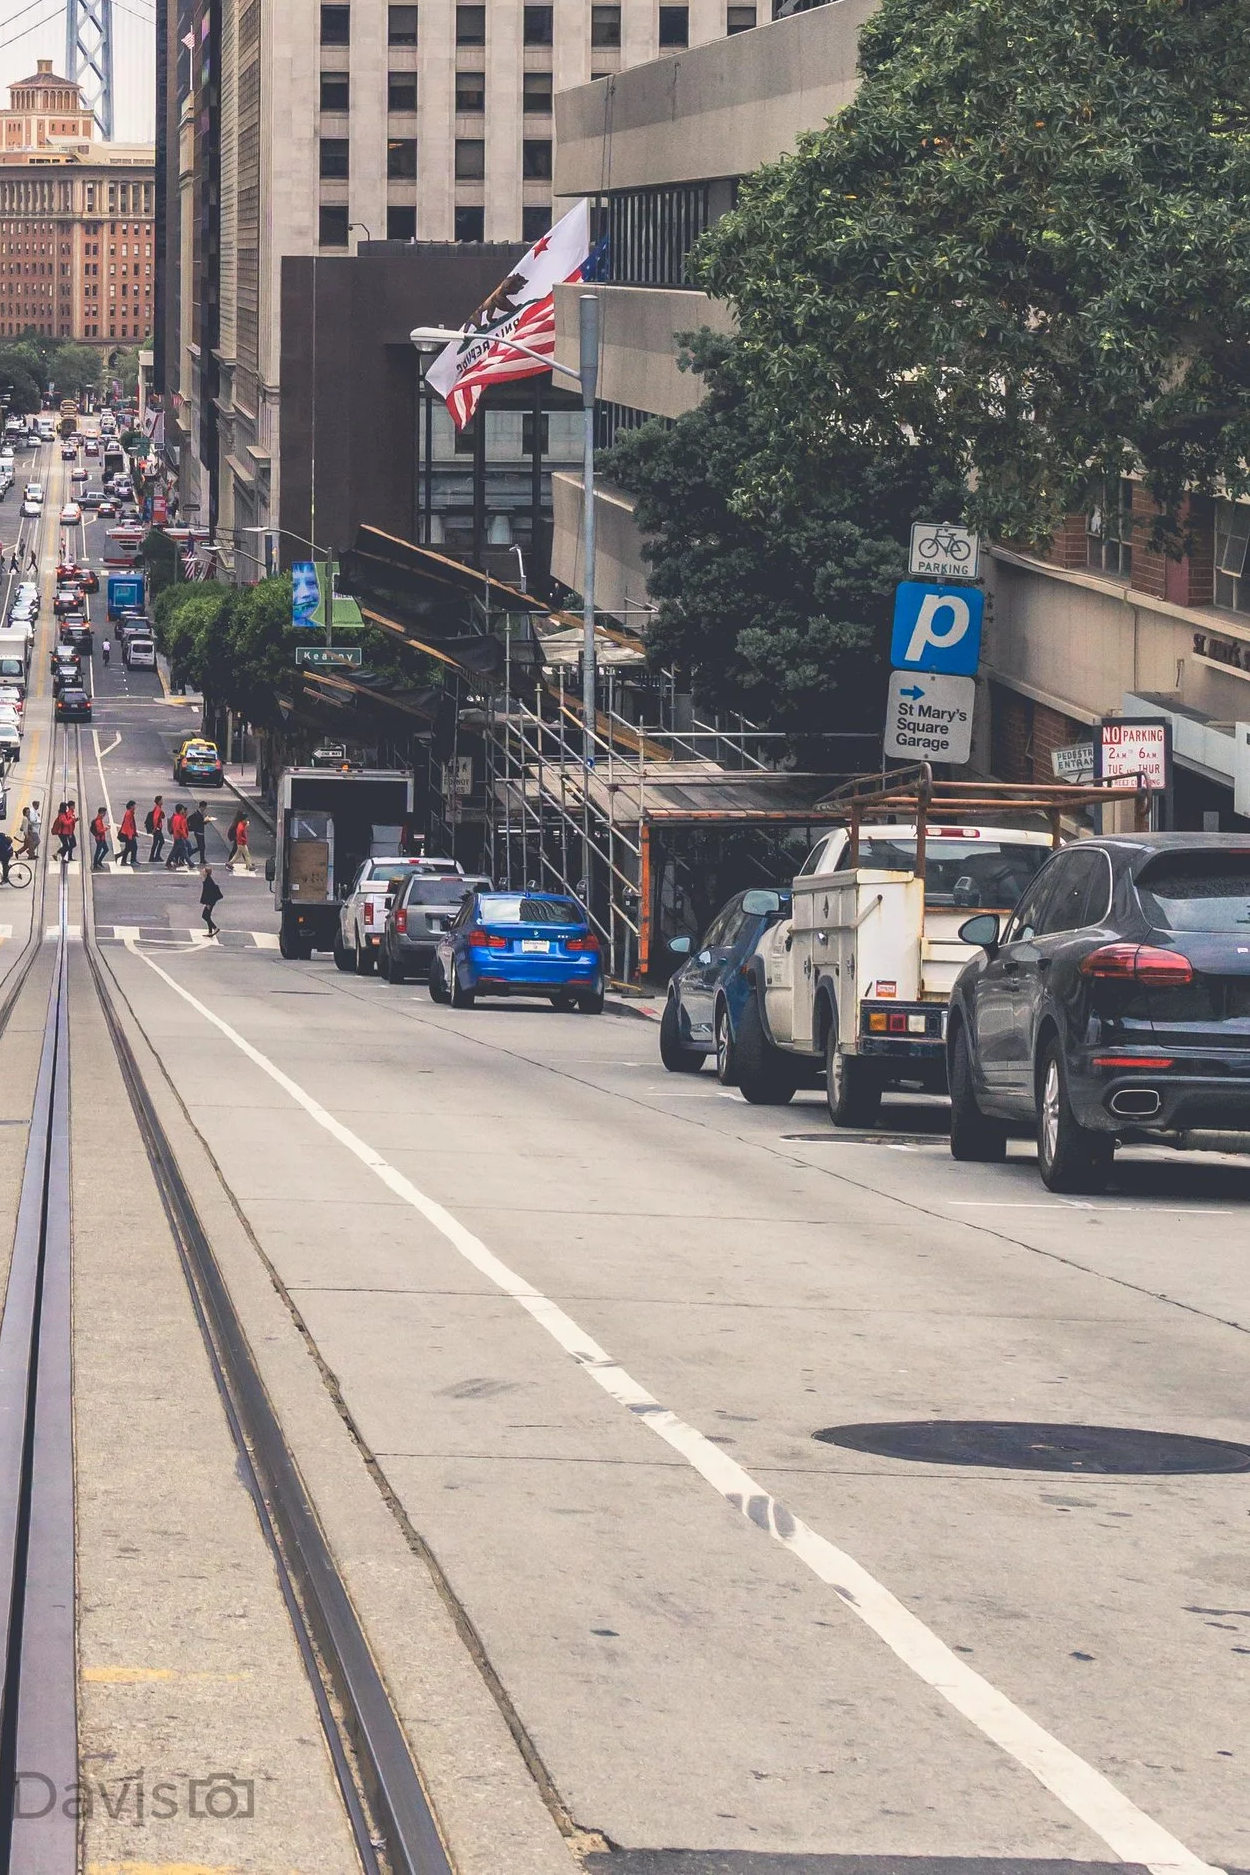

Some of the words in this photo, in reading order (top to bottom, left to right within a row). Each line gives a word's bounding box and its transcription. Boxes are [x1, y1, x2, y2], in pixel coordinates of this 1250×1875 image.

[918, 562, 969, 575] PARKING
[898, 702, 914, 716] St
[918, 704, 967, 723] Mary's
[897, 718, 949, 735] Square
[1103, 726, 1120, 743] NO
[1123, 729, 1163, 742] PARKING
[896, 733, 949, 752] Garage
[1057, 749, 1093, 761] PEDESTR
[1108, 764, 1123, 775] TUE
[1138, 764, 1160, 775] THUR
